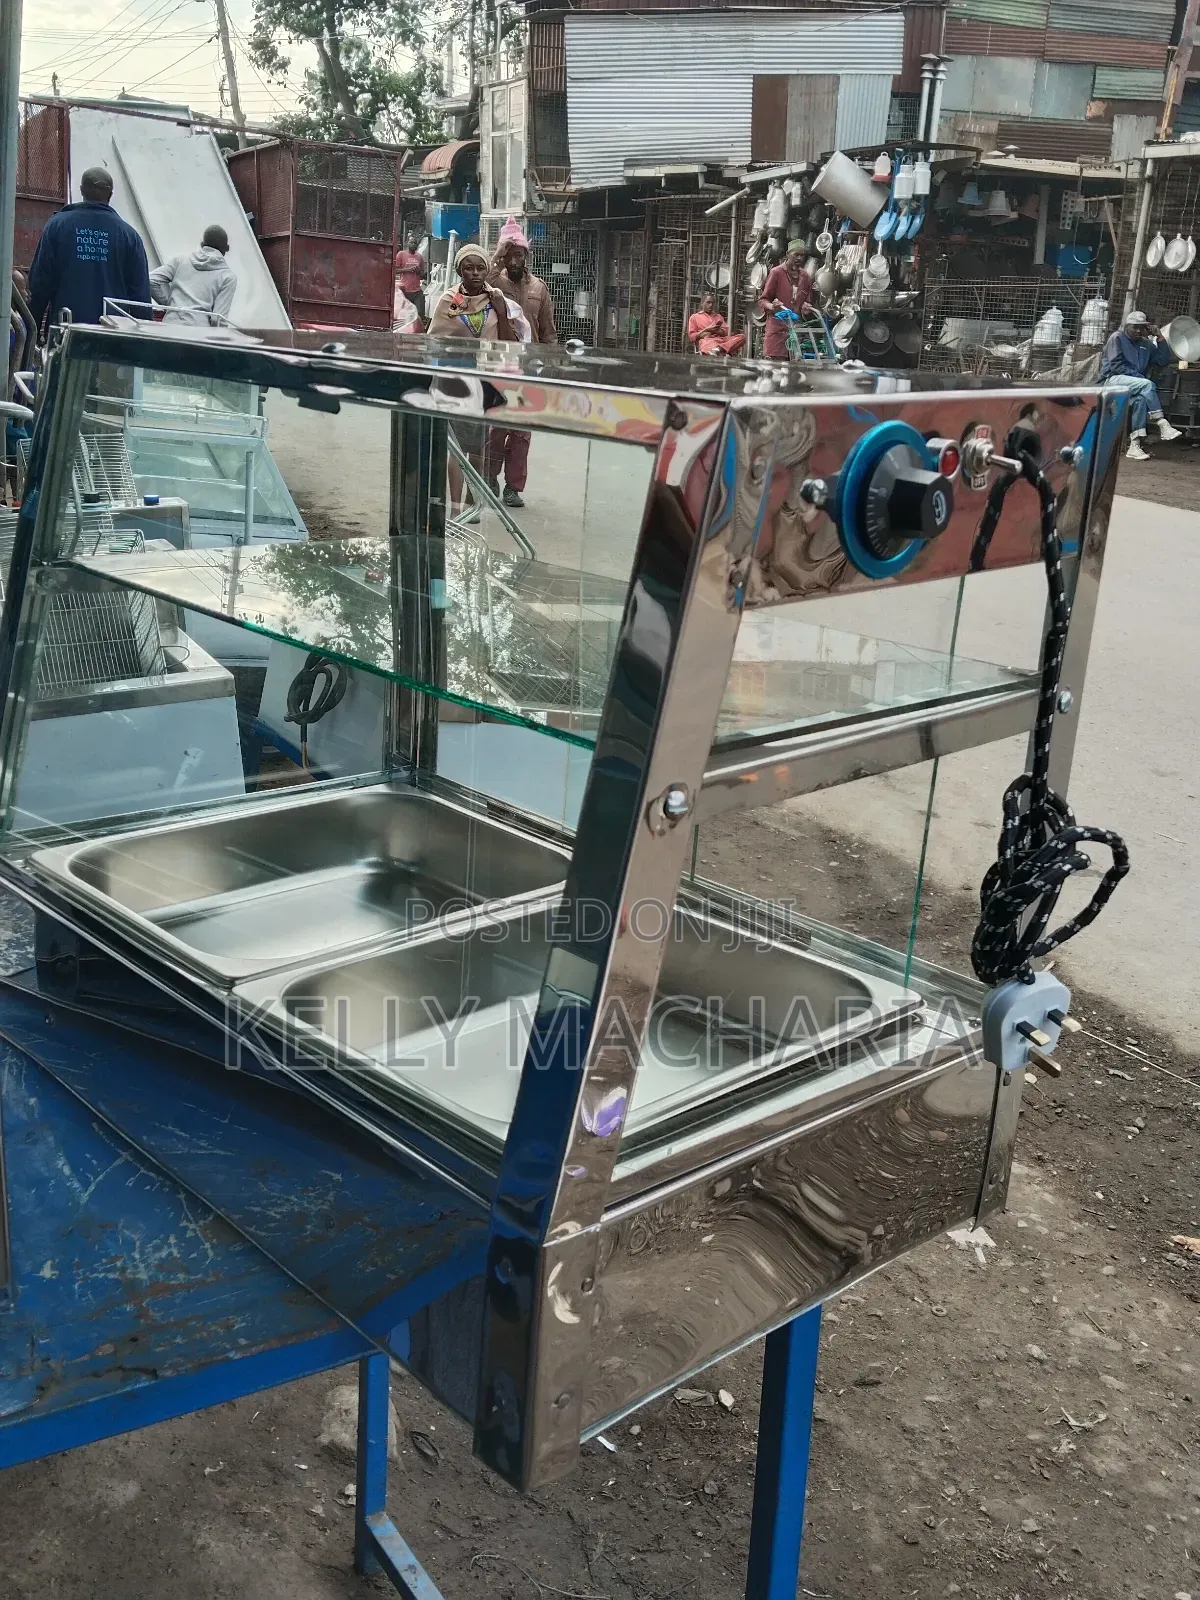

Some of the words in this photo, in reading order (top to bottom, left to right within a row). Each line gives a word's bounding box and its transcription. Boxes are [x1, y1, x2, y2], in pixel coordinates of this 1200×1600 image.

[75, 227, 93, 236] Let's
[94, 229, 109, 238] give
[76, 236, 109, 246] nature
[85, 244, 109, 255] home
